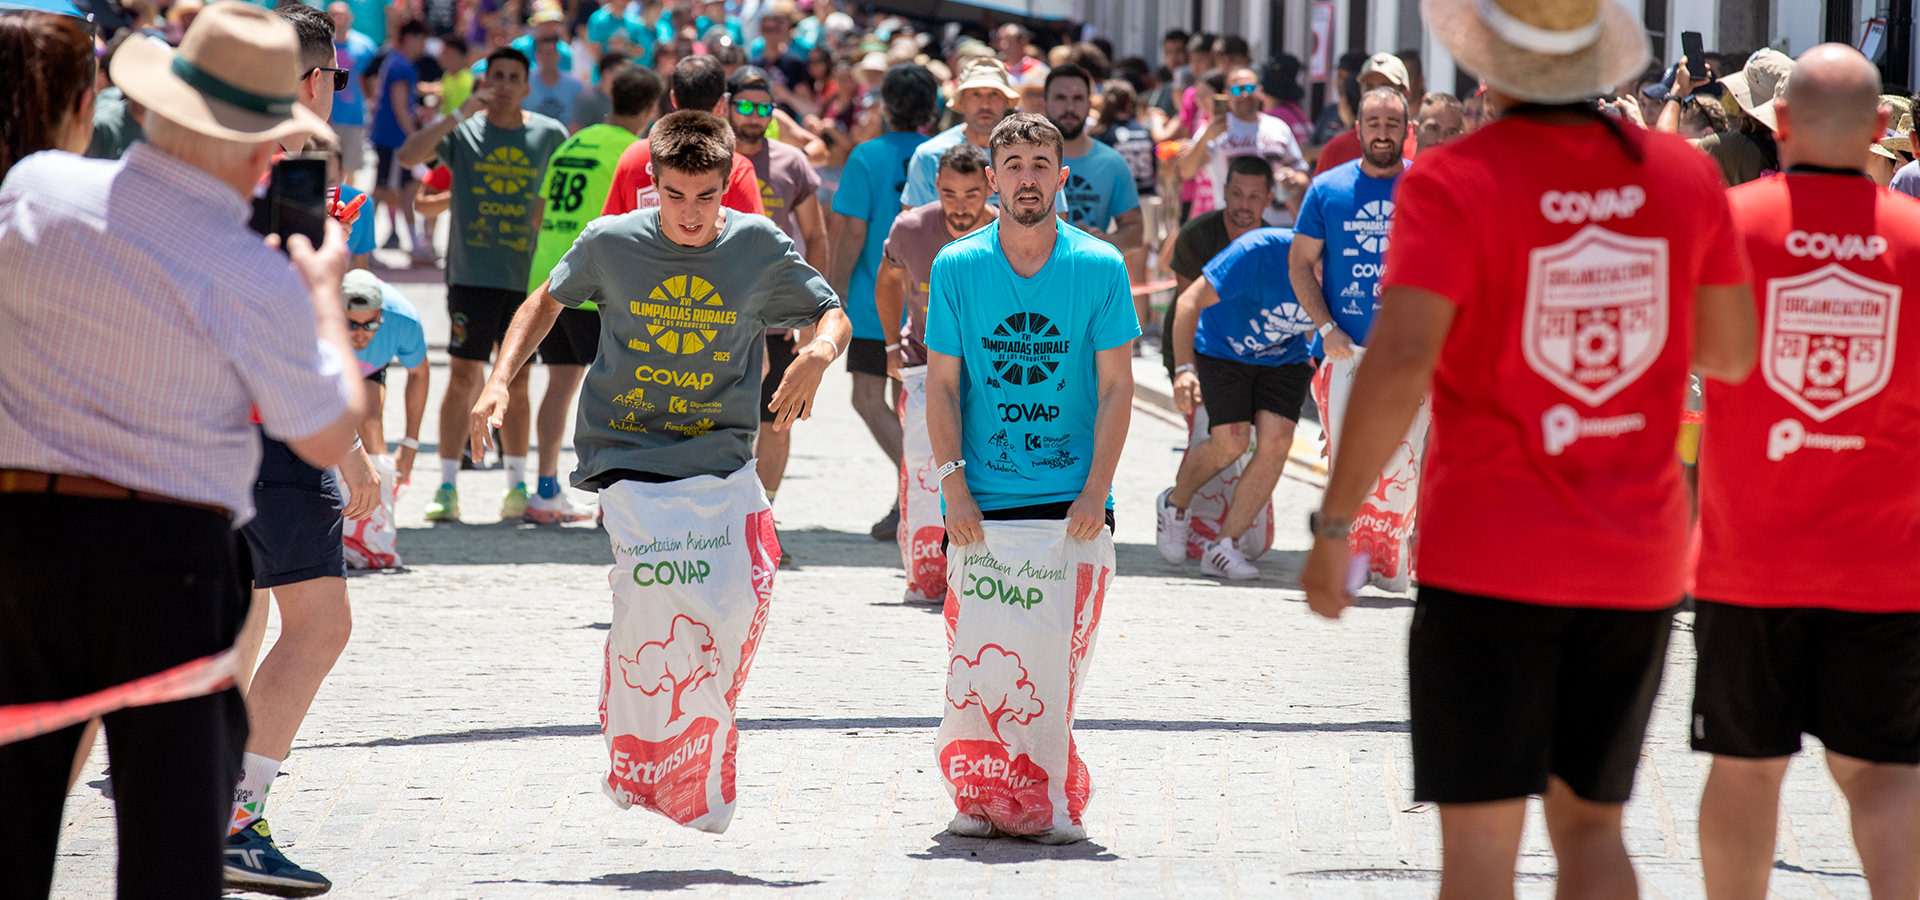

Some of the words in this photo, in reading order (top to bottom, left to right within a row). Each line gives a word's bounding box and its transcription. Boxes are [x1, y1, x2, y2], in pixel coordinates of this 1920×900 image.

[549, 170, 587, 213] 48
[1540, 184, 1647, 224] COVAP
[1785, 230, 1888, 260] COVAP
[630, 301, 692, 321] OLIMPIADAS
[692, 308, 737, 325] RURALES
[680, 297, 692, 307] XVI
[663, 319, 674, 327] LOS
[713, 351, 731, 362] 2025
[635, 365, 714, 390] COVAP
[687, 524, 731, 551] Animal
[633, 560, 711, 587] COVAP
[1017, 559, 1068, 581] Animal
[613, 734, 710, 784] Extensivo
